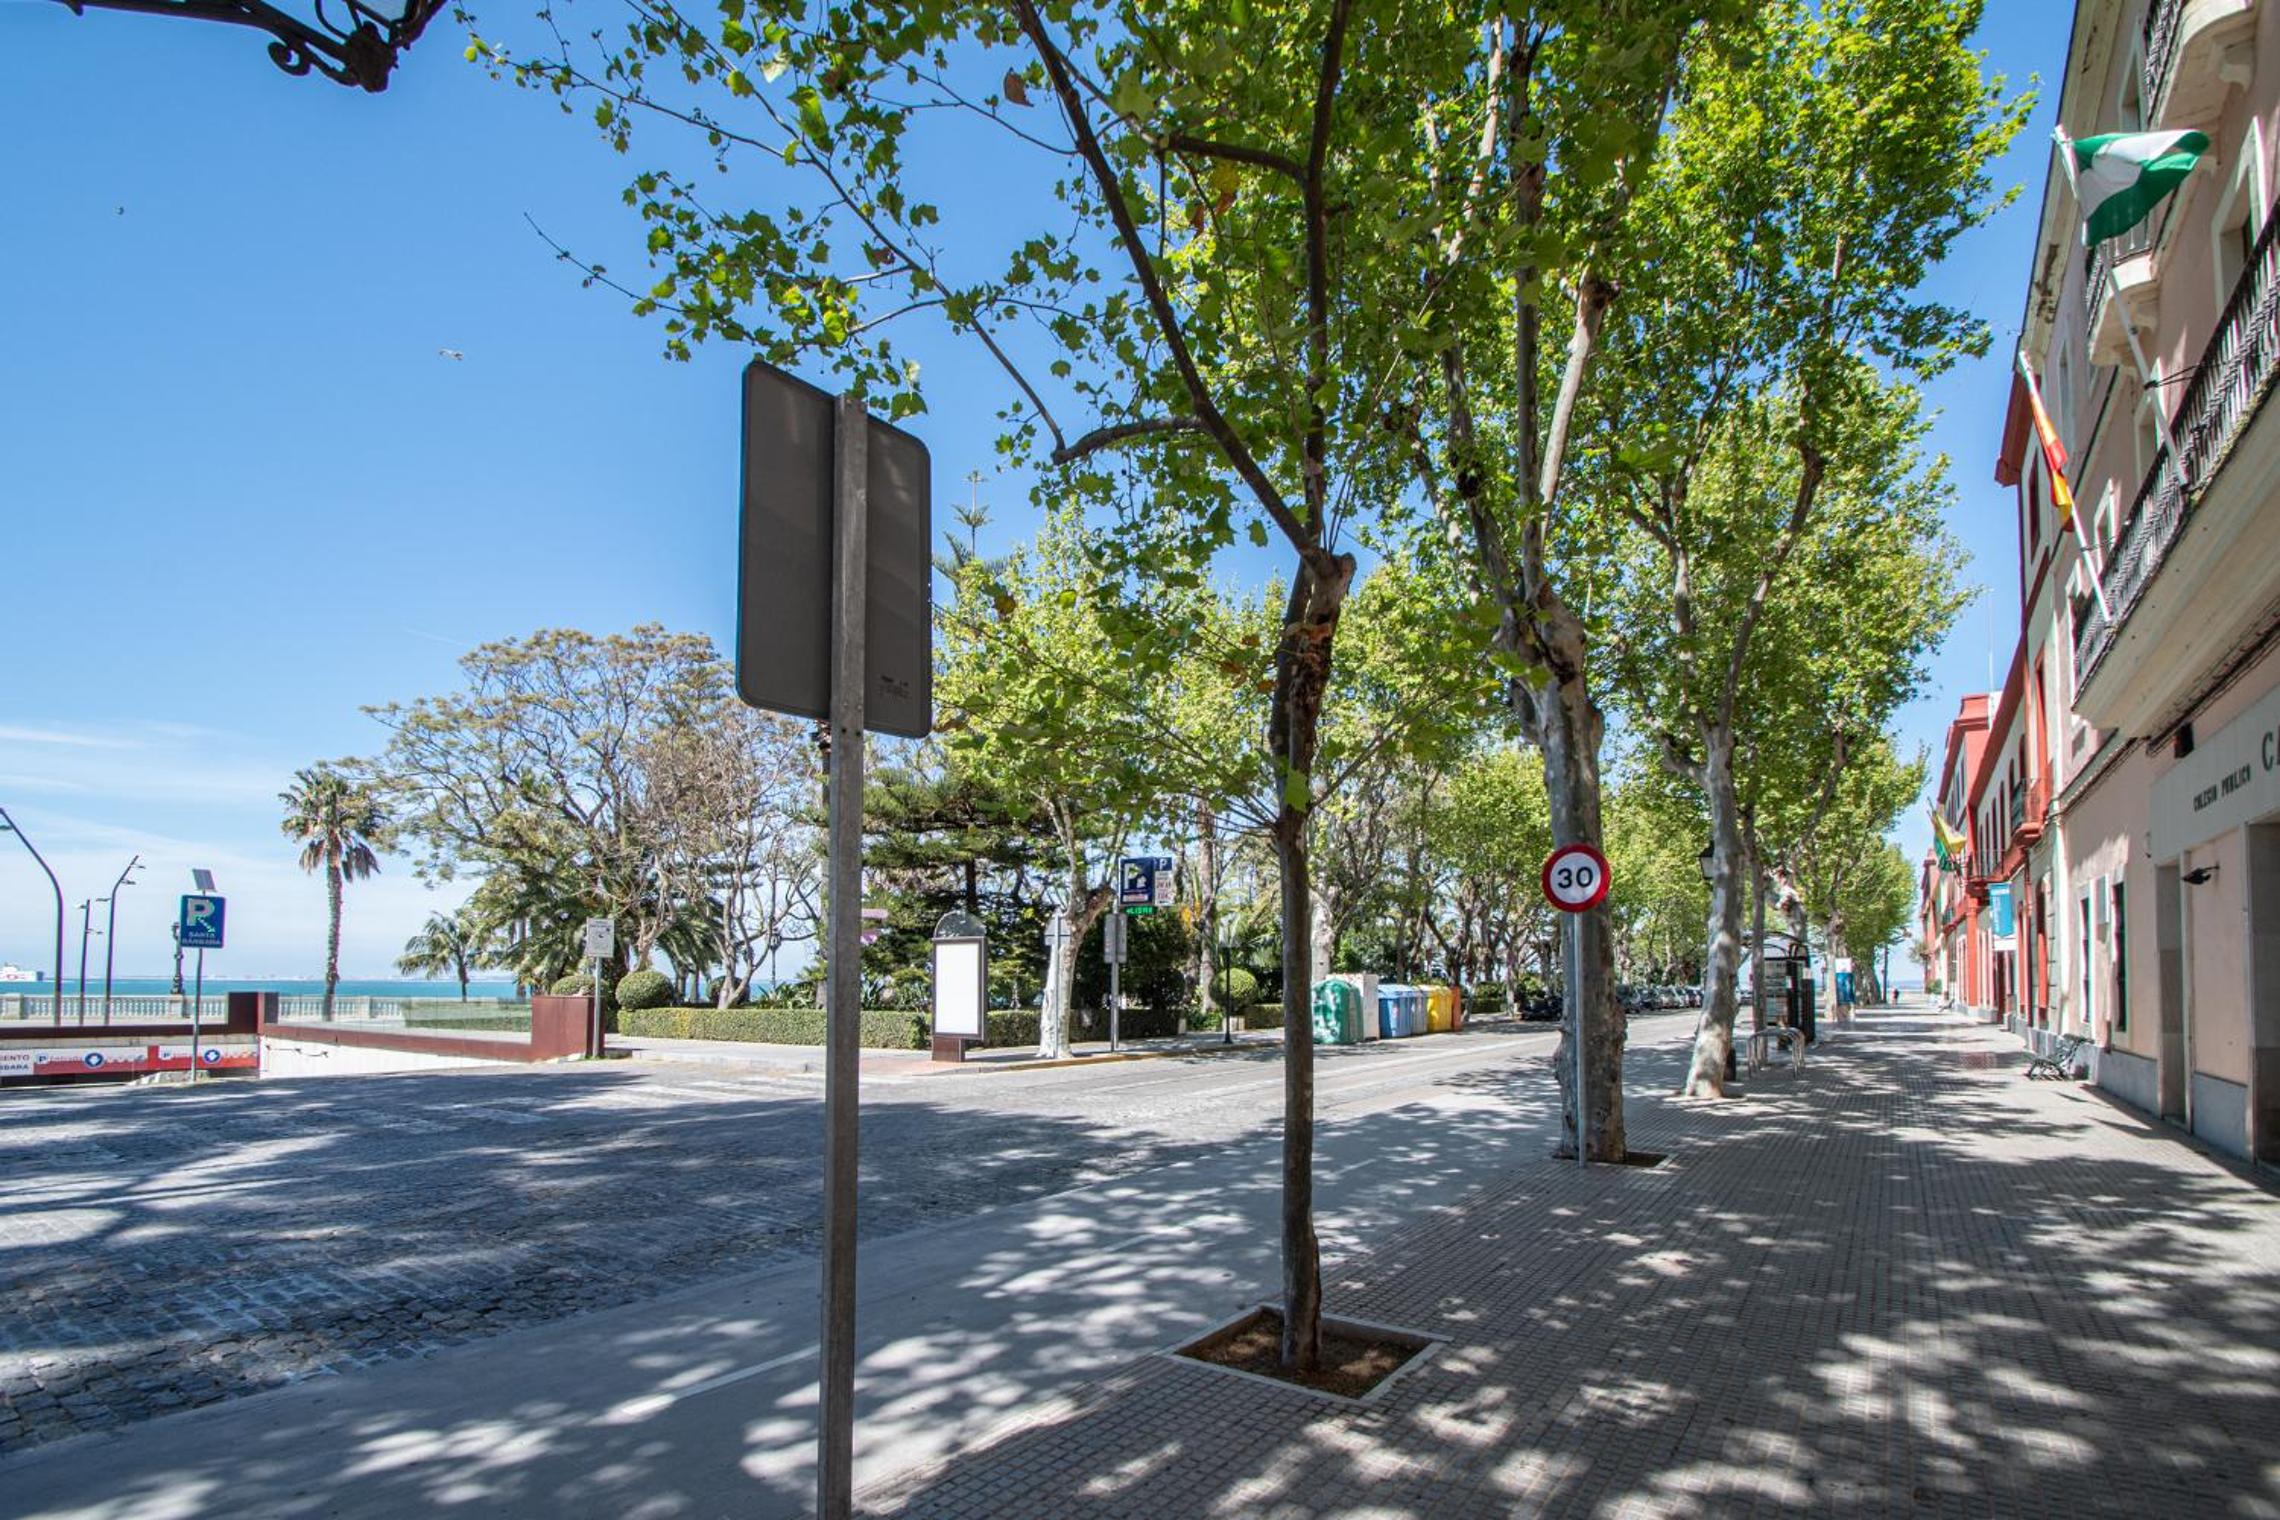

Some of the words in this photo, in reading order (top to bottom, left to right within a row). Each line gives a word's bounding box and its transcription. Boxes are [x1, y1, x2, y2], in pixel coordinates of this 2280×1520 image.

[2262, 725, 2280, 772] C
[1557, 866, 1594, 889] 30
[187, 898, 215, 926] P
